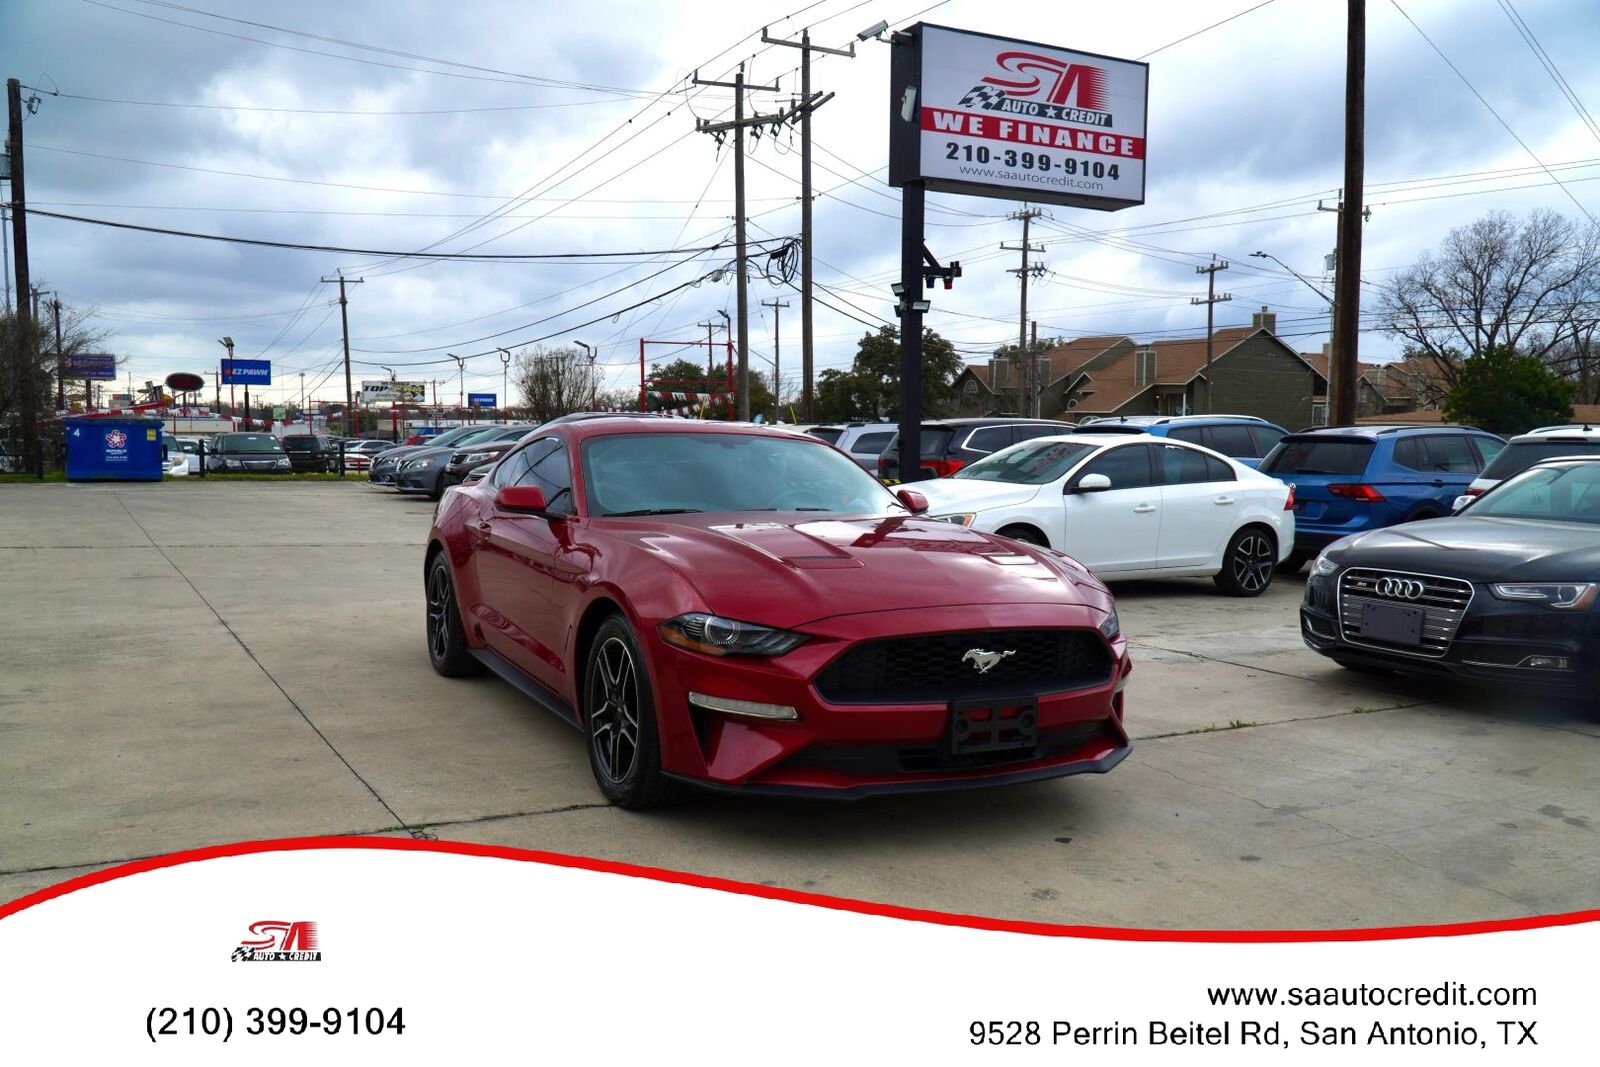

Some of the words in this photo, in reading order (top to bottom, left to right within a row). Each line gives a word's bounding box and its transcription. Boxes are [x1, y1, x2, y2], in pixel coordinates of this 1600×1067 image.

[981, 51, 1111, 111] SA
[1001, 98, 1039, 116] AUTO
[1062, 108, 1109, 126] CREDIT
[933, 111, 984, 135] WE
[999, 121, 1134, 156] FINANCE
[946, 142, 1120, 180] 210-399-9104
[959, 165, 1104, 192] www.saautocredit.com
[73, 427, 81, 438] 4
